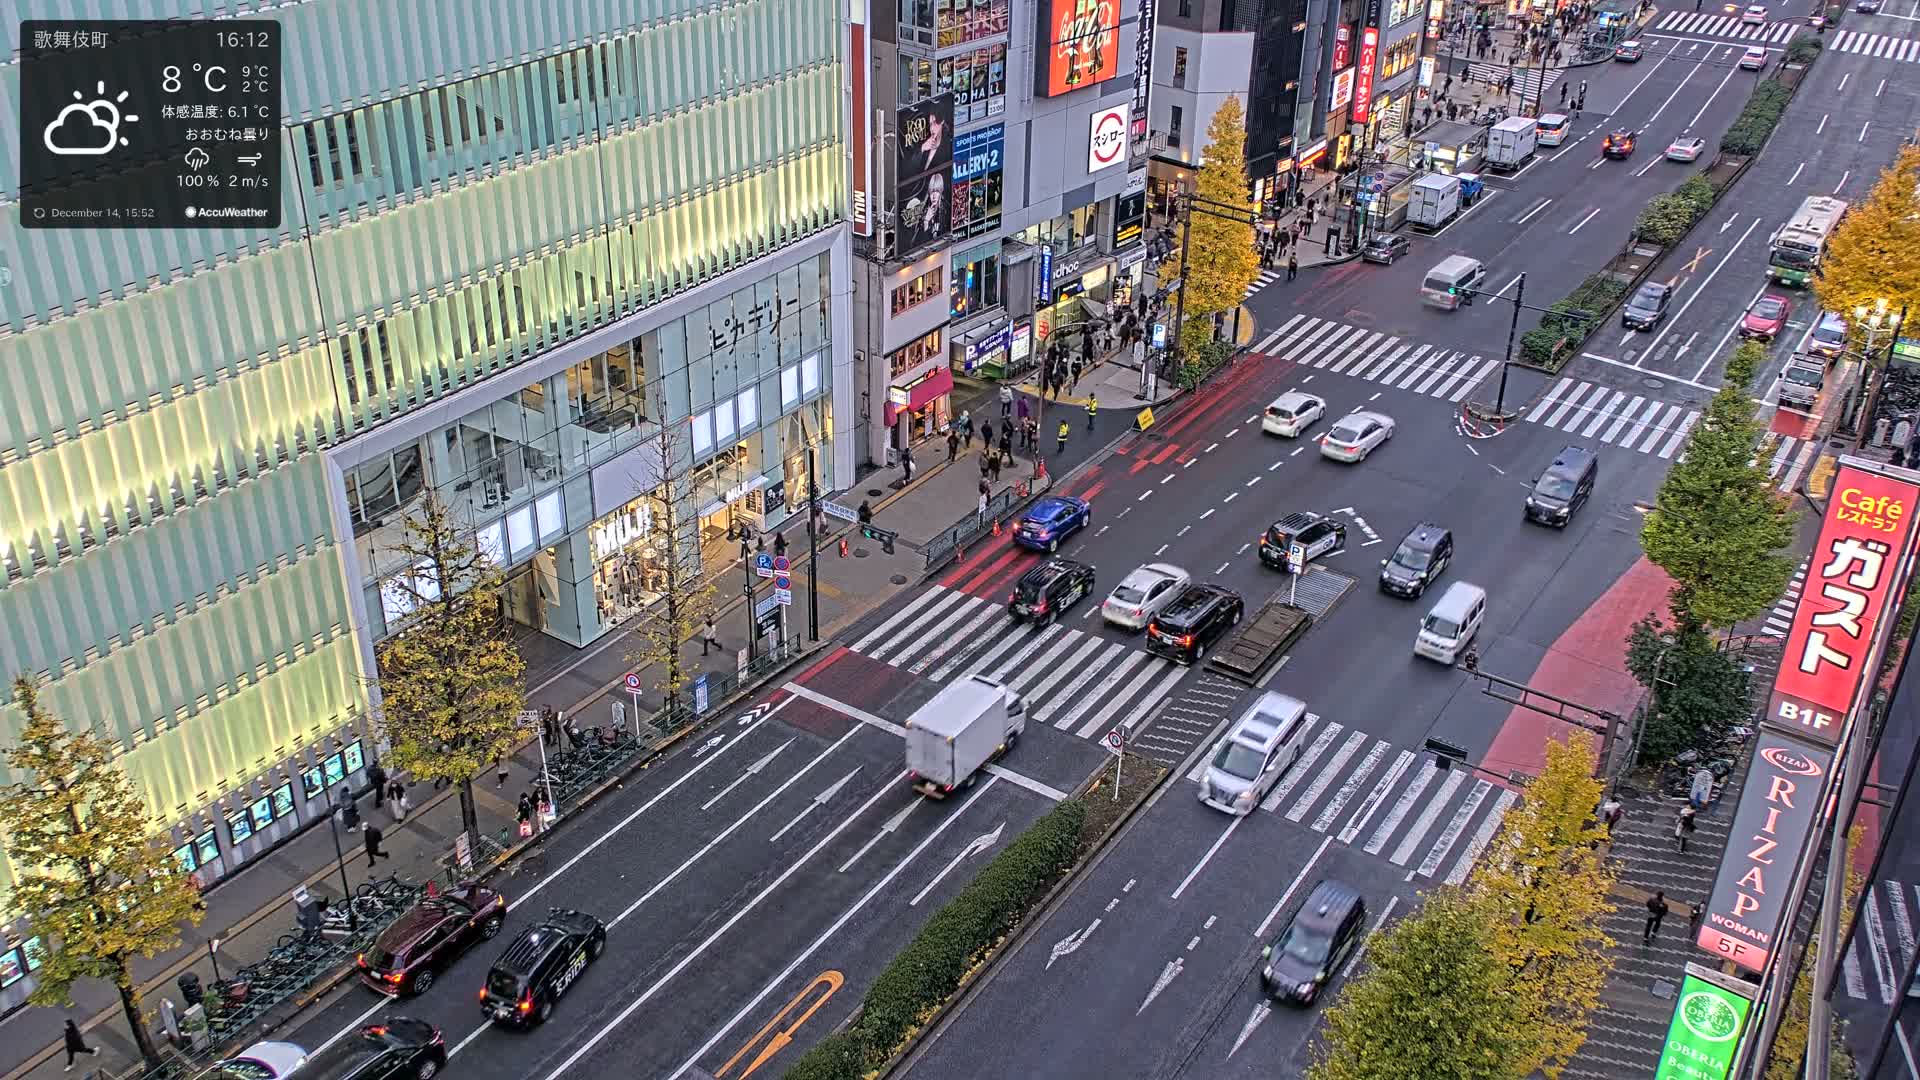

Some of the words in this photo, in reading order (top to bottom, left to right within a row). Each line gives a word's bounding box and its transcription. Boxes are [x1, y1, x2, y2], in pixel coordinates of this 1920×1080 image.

[1357, 48, 1374, 113] バーガーキング
[956, 134, 976, 147] SPORTS
[1094, 130, 1125, 147] スシロー
[854, 190, 866, 224] MUJI
[713, 299, 797, 355] ピカデリー
[1155, 326, 1163, 335] P
[726, 481, 748, 503] MUJI
[1841, 488, 1902, 519] Café
[595, 503, 651, 556] MUJI
[1837, 507, 1897, 531] レストラン
[759, 558, 767, 567] P
[1292, 546, 1300, 555] P
[1801, 537, 1889, 674] ガスト
[1778, 701, 1833, 729] B1F
[1776, 753, 1808, 768] RIZAP
[1731, 775, 1795, 918] RIZAP
[1711, 913, 1768, 943] WOMAN
[1718, 938, 1747, 958] 5F
[1687, 1006, 1729, 1028] OBERIA
[1669, 1041, 1724, 1072] OBERIA
